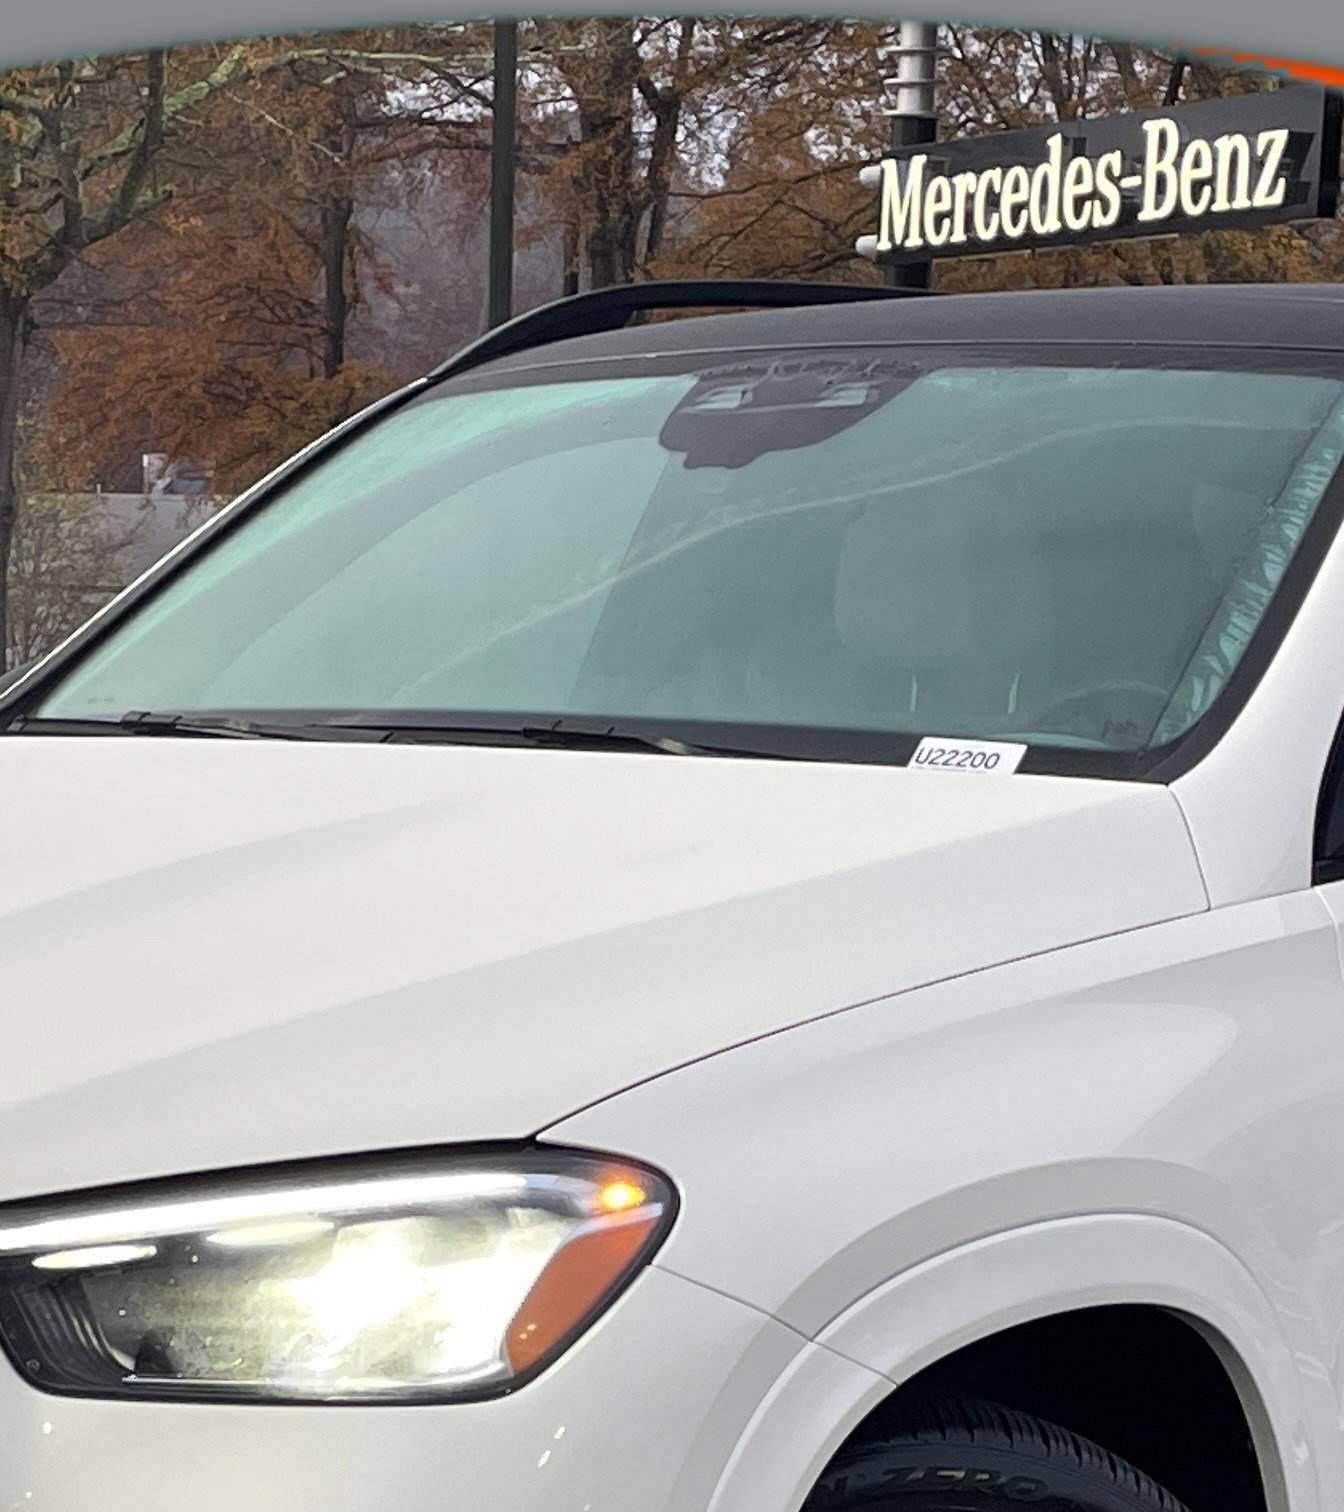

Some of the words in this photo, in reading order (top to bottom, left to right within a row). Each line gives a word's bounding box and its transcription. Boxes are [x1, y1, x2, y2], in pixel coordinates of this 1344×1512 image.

[876, 118, 1290, 251] Mercedes-Benz
[914, 746, 1001, 770] U22200
[880, 1465, 1050, 1502] ZERO
